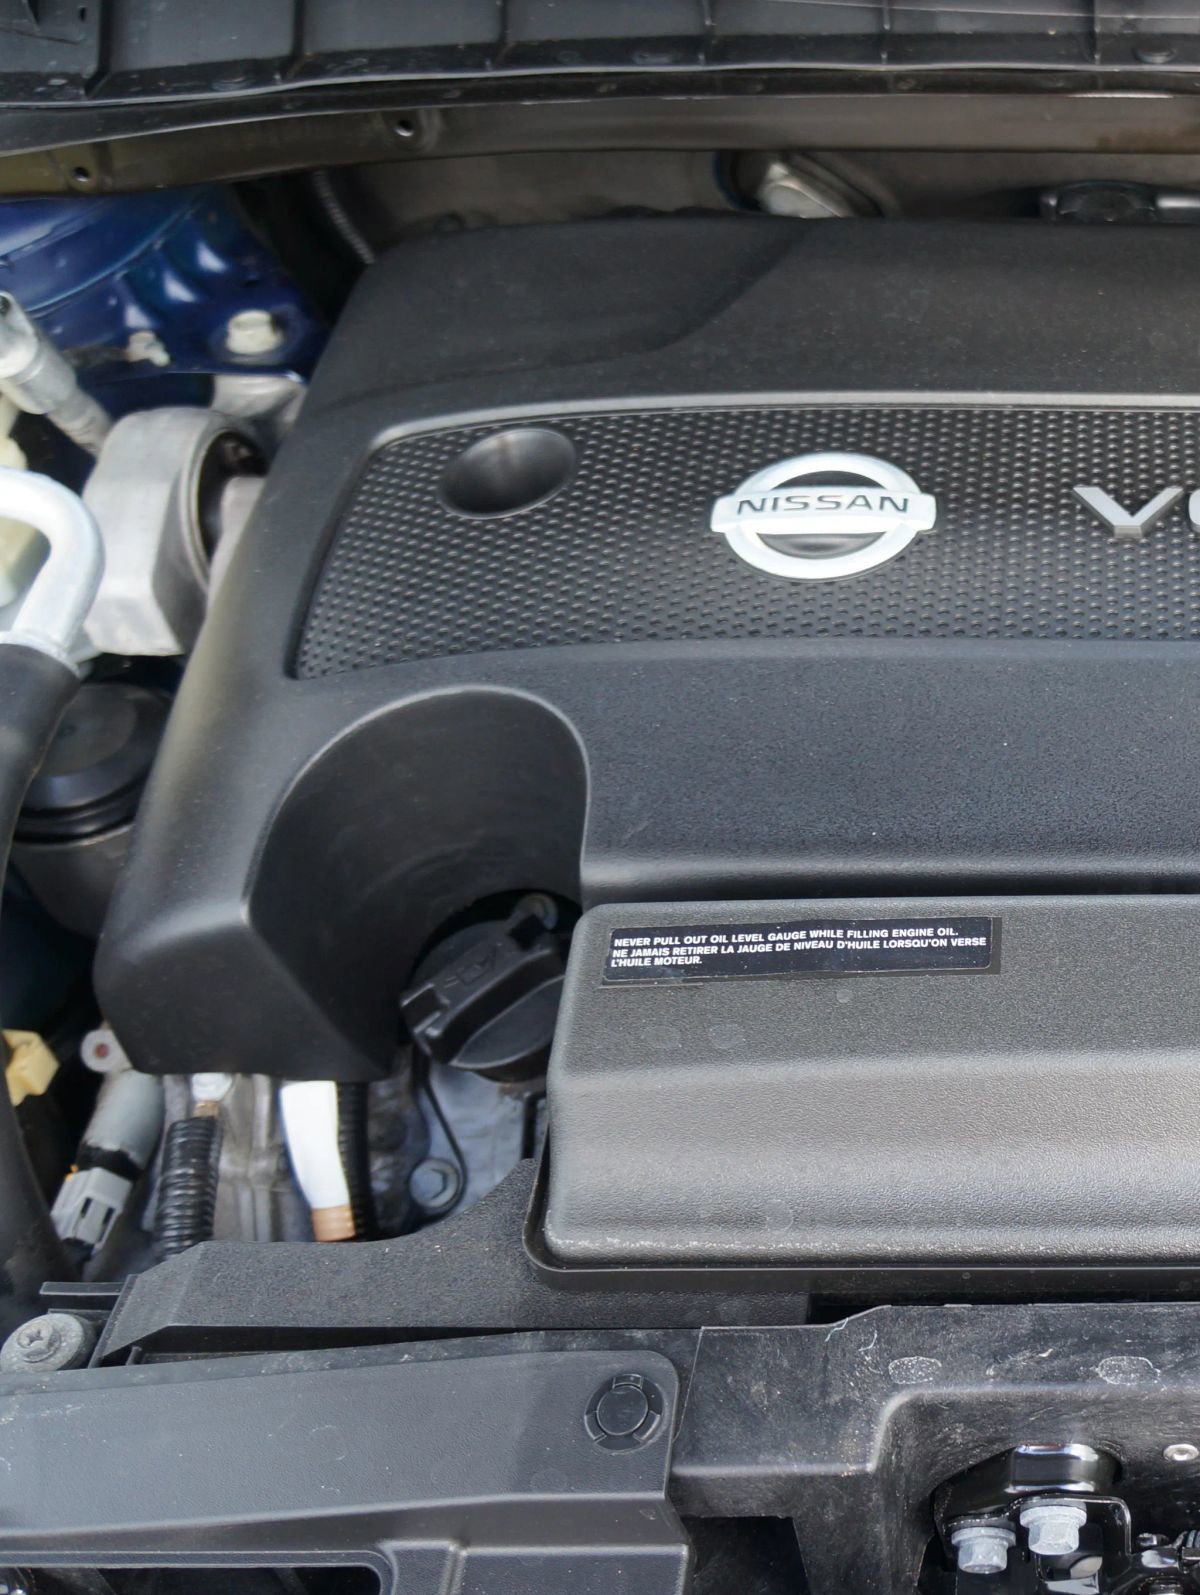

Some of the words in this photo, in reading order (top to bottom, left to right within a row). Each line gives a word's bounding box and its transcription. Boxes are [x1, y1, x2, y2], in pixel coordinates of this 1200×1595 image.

[736, 493, 910, 515] NISSAN
[612, 949, 628, 958] NE
[630, 947, 670, 957] JAMAIS
[672, 945, 718, 956] RETIRER
[720, 945, 735, 954] LA
[736, 943, 773, 954] JAUGE
[775, 942, 791, 952] DE
[793, 940, 834, 950] NIVEAU
[836, 940, 880, 950] D'HUILE
[883, 938, 948, 949] LORSQU'ON
[950, 936, 987, 947] VERSE
[614, 937, 651, 947] NEVER
[653, 936, 681, 946] PULL
[683, 935, 708, 945] OUT
[710, 934, 729, 944] OIL
[731, 933, 765, 943] LEVEL
[767, 930, 807, 941] GAUGE
[809, 929, 844, 939] WHILE
[846, 929, 889, 939] FILLING
[892, 928, 934, 938] ENGINE
[937, 927, 959, 936] OIL.
[610, 957, 652, 968] L'HUILE
[653, 955, 702, 966] MOTEUR.
